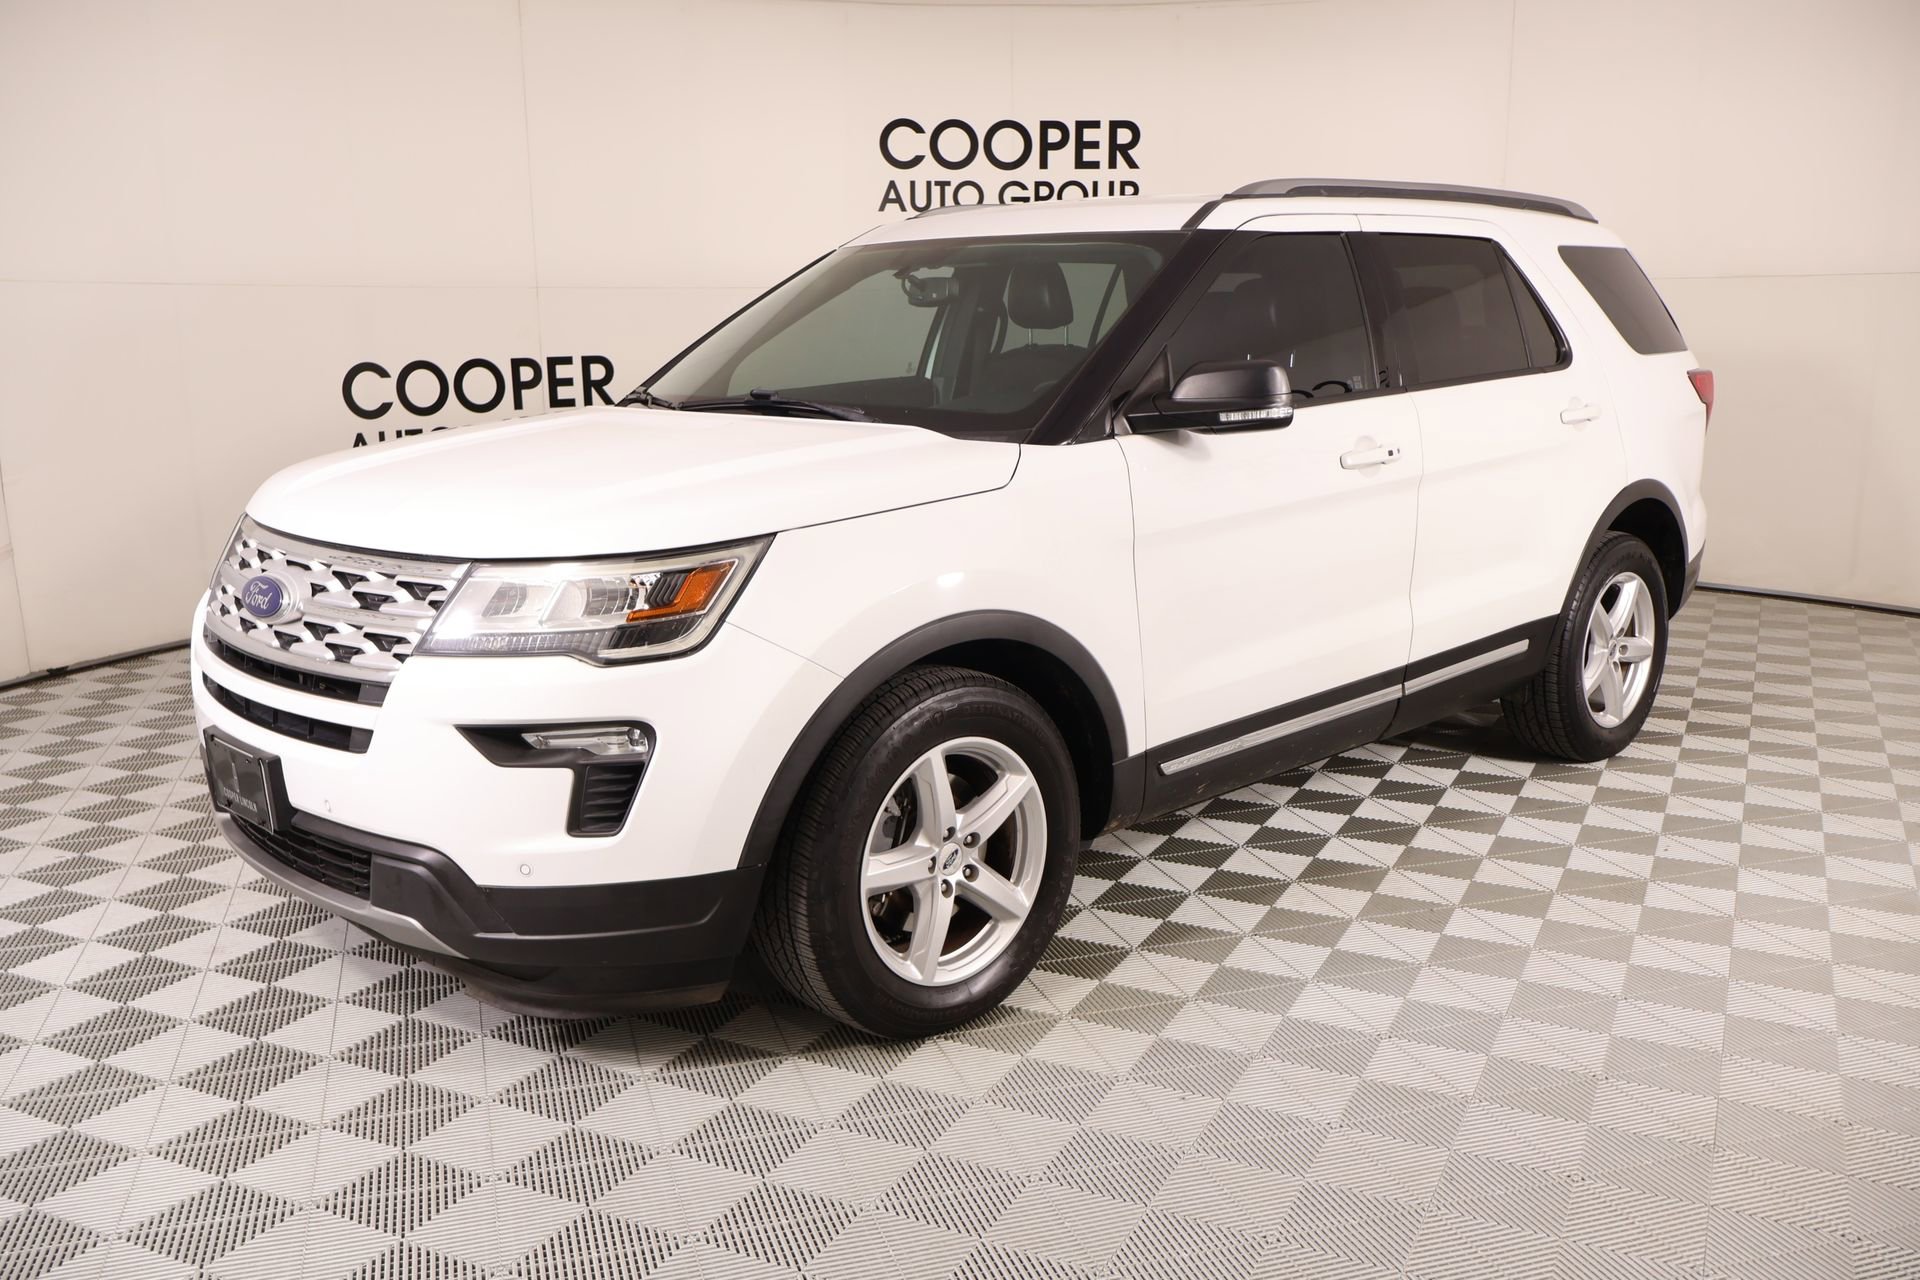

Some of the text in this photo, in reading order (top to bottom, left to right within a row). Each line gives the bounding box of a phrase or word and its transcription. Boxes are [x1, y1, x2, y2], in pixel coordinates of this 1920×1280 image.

[879, 118, 1141, 170] COOPER
[878, 180, 984, 212] AUTO
[342, 355, 617, 420] COOPER
[245, 581, 272, 610] Ford
